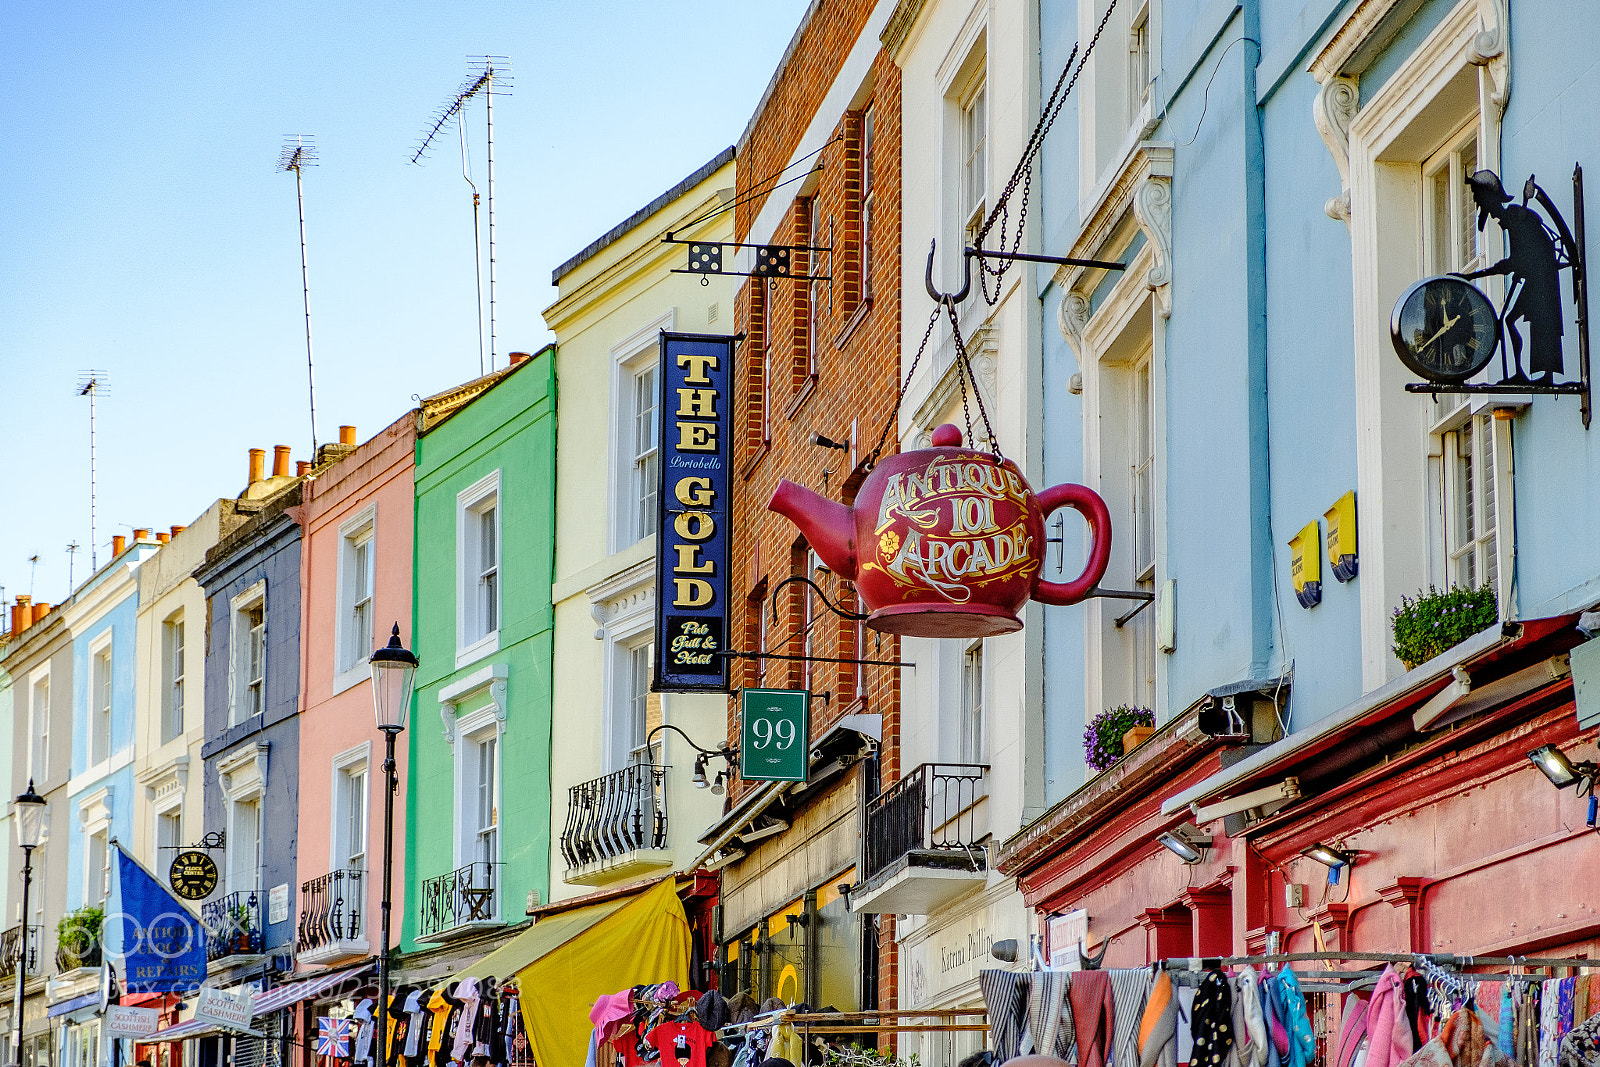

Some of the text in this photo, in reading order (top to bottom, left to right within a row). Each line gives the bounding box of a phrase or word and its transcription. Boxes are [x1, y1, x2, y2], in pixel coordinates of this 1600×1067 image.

[675, 354, 721, 454] THE
[669, 455, 722, 471] Portobello
[874, 455, 1032, 536] ANTIQUE
[949, 496, 1001, 537] 101
[672, 475, 718, 610] GOLD
[886, 523, 1034, 603] ARCADE
[680, 621, 710, 636] Pub
[670, 635, 718, 653] Grill &
[673, 651, 714, 665] Hotel
[752, 717, 796, 750] 99
[132, 926, 196, 940] ANTIQUE
[137, 941, 194, 955] CLOCKS
[941, 946, 966, 974] Katrina
[136, 964, 199, 978] REPAIRS
[207, 997, 246, 1013] SCOTTISH
[114, 1013, 151, 1025] SCOTTISH
[201, 1006, 247, 1024] CASHMERE
[110, 1022, 153, 1034] CASHMERE
